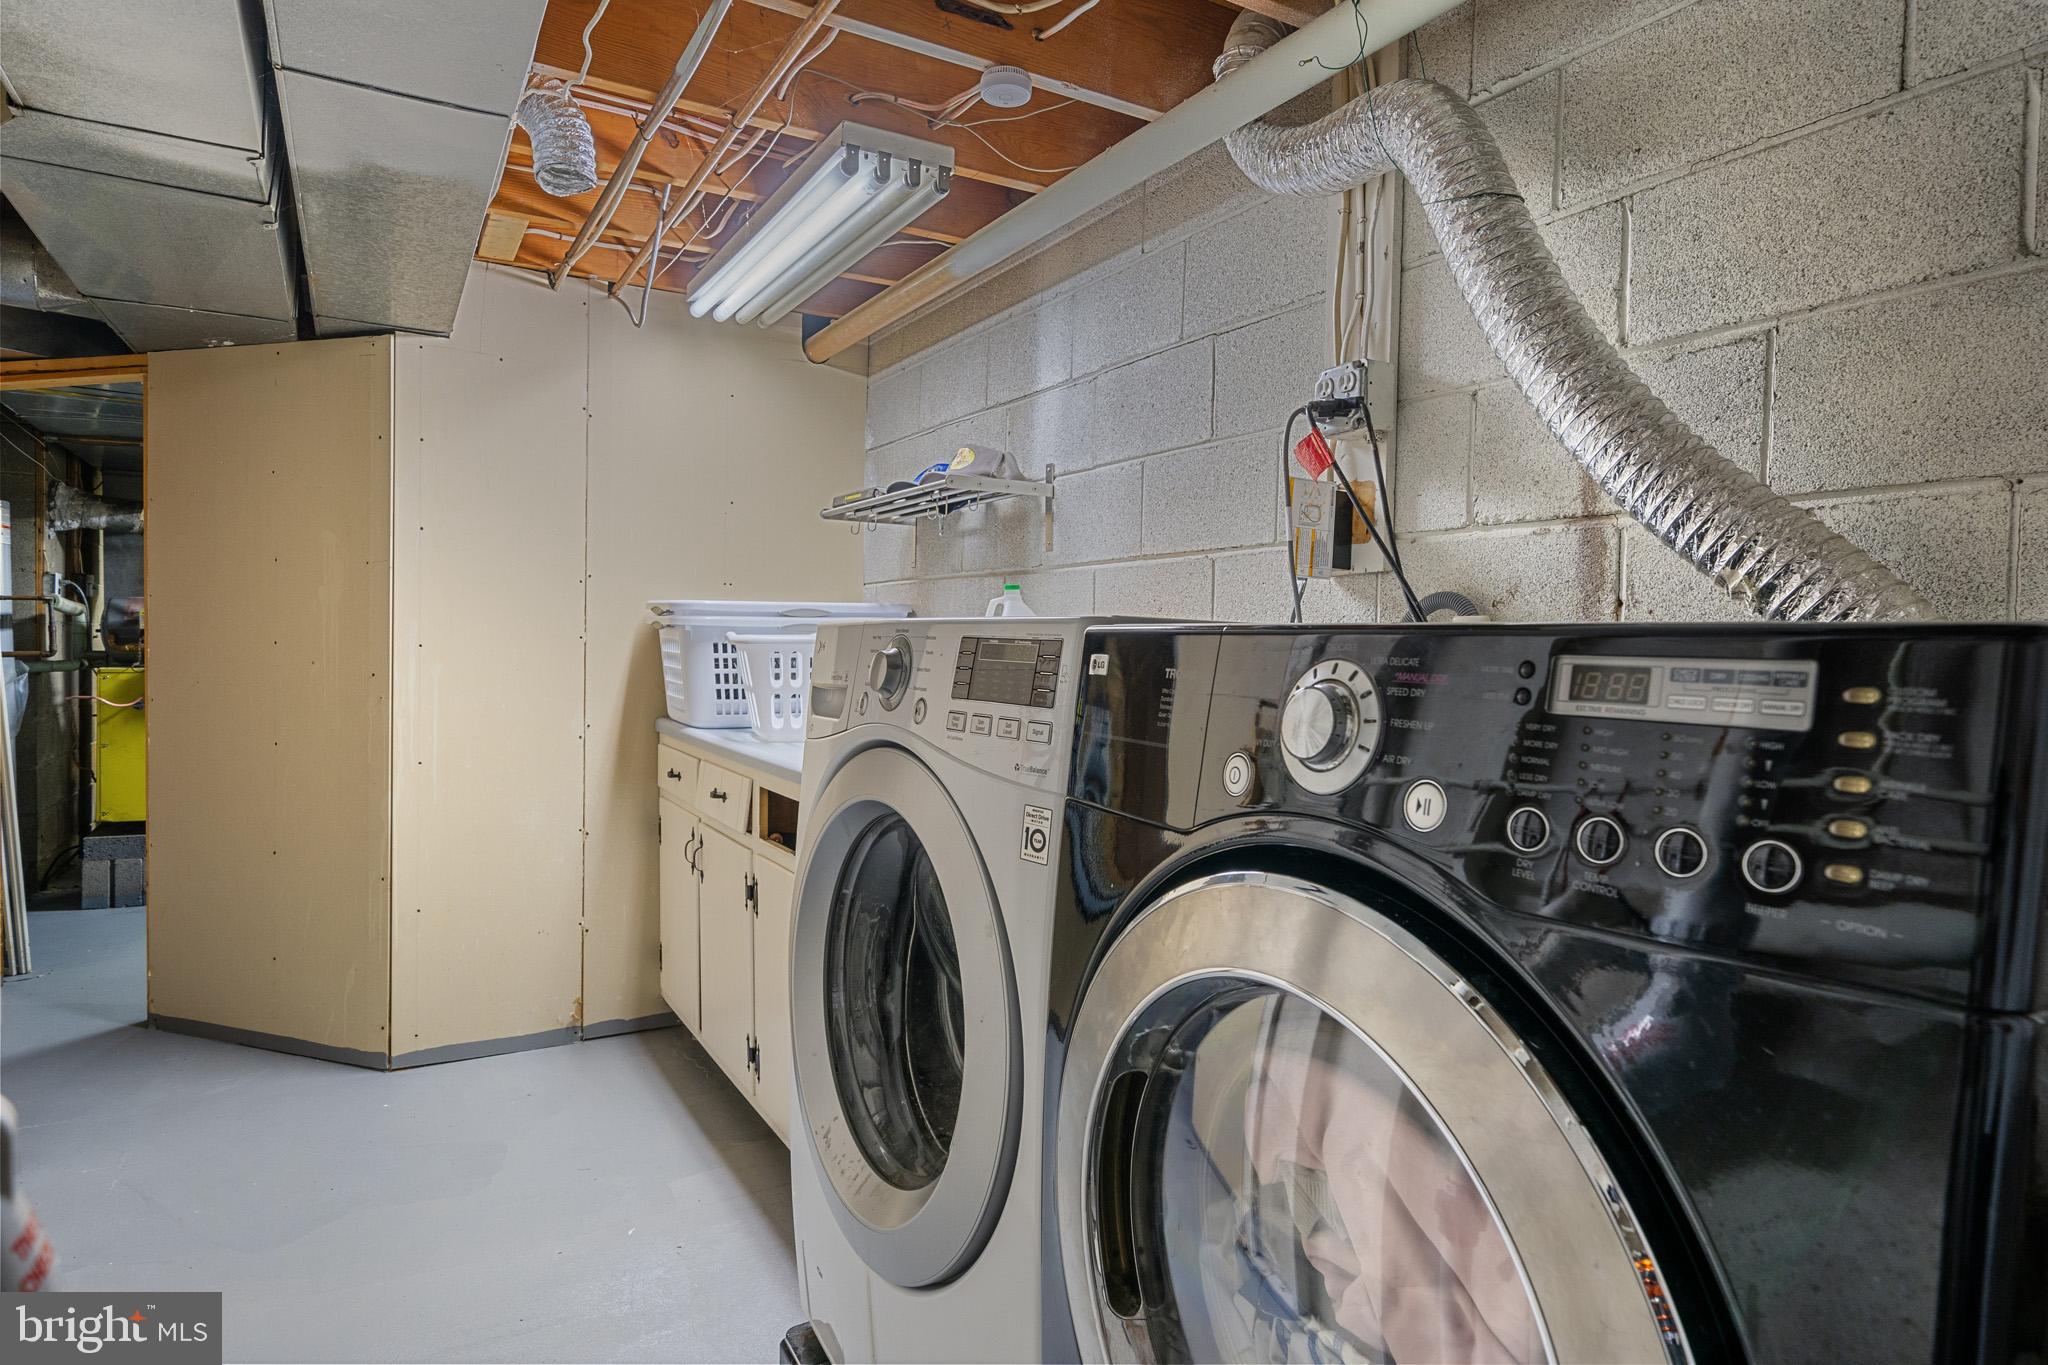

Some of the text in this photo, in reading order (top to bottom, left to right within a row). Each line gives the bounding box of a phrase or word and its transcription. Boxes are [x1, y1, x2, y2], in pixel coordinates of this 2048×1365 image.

[1389, 657, 1420, 667] DELICATE
[1386, 687, 1426, 698] SPEED DRY
[1390, 719, 1434, 731] FRESHEN UP
[1542, 724, 1557, 732] DRY
[1544, 741, 1559, 750] DRY
[1383, 755, 1412, 765] AIR DRY
[1534, 774, 1548, 782] DRY
[1026, 811, 1038, 820] Direct
[1024, 826, 1047, 853] 10
[1516, 858, 1535, 869] DRY
[1511, 868, 1536, 881] LEVEL
[1571, 880, 1619, 899] CONTROL
[1834, 919, 1888, 938] OPTION
